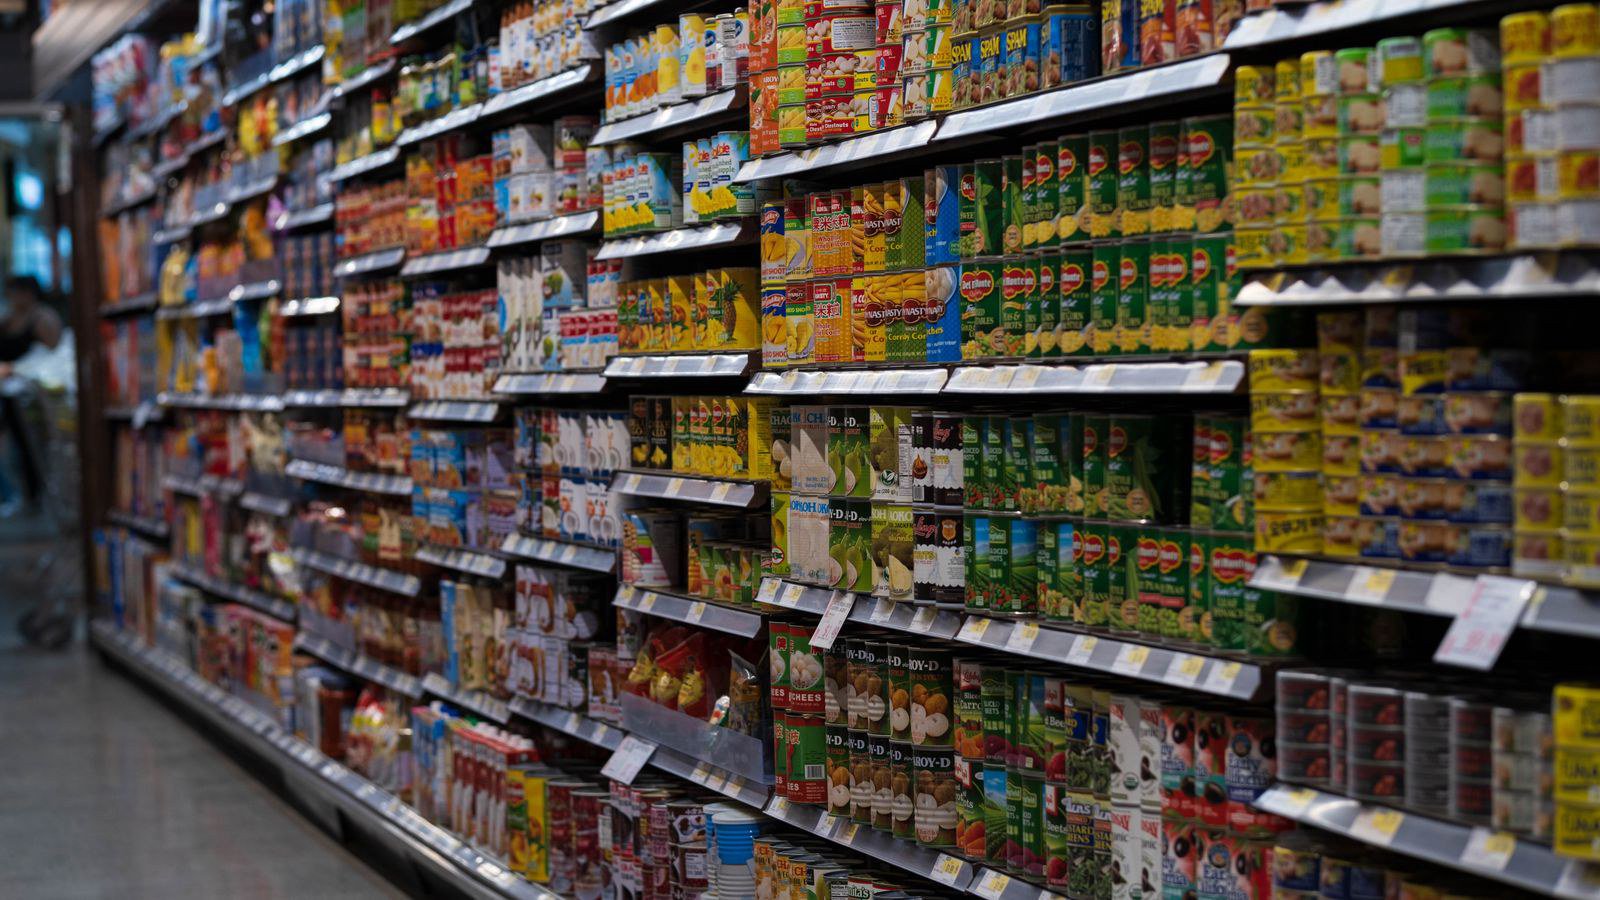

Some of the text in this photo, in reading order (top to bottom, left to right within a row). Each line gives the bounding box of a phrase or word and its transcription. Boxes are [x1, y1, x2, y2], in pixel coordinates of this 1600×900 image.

[980, 35, 999, 59] SPAM
[1005, 27, 1028, 51] SPAM
[951, 43, 972, 64] SPAM
